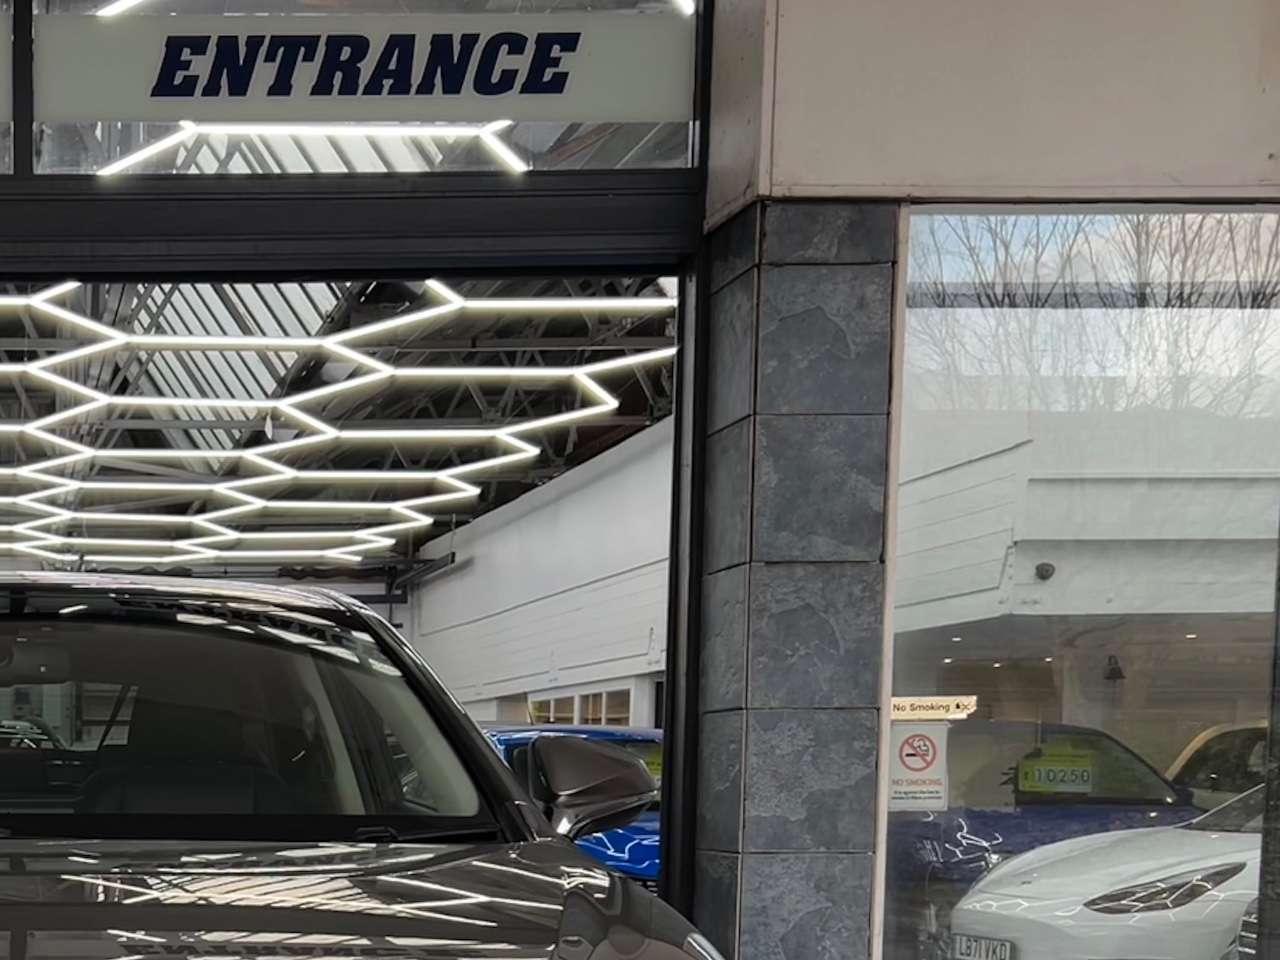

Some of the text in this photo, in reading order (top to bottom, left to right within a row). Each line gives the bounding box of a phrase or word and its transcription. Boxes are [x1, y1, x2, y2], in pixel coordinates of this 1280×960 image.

[150, 31, 581, 97] ENTRANCE
[892, 702, 951, 713] No Smoking
